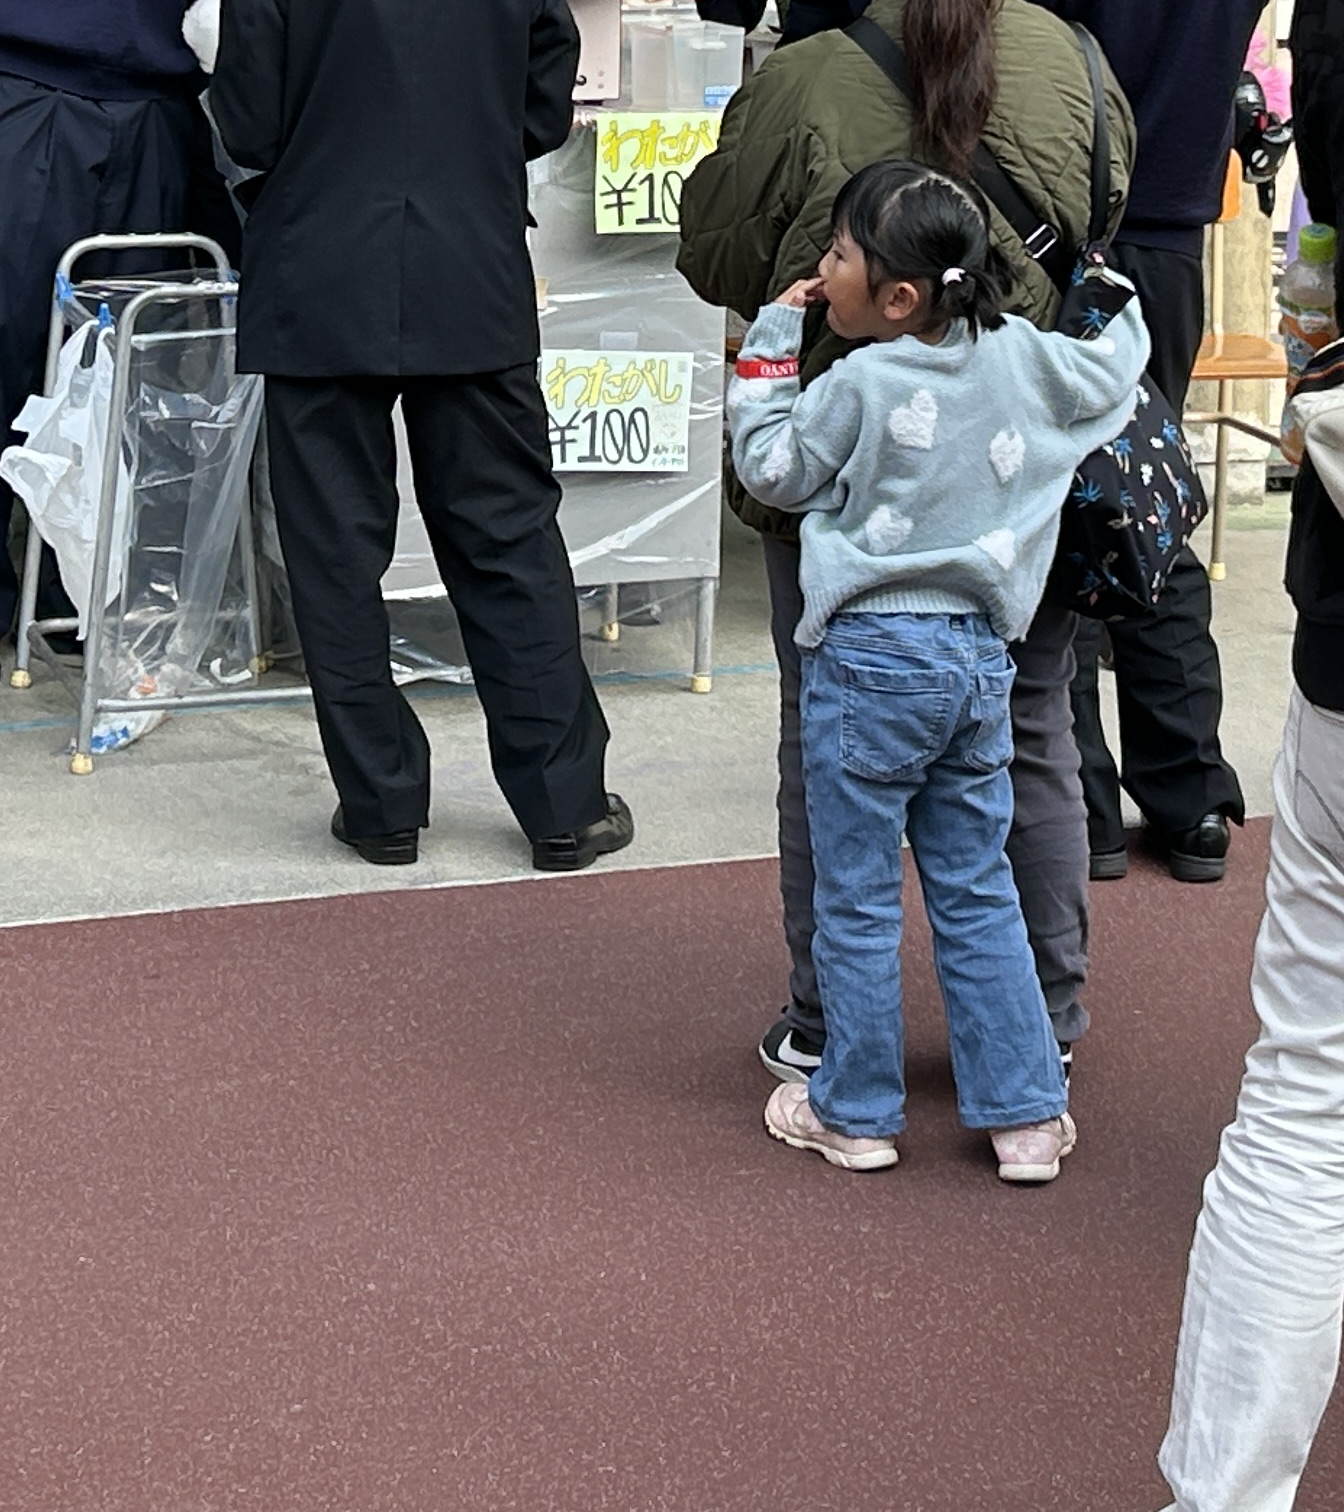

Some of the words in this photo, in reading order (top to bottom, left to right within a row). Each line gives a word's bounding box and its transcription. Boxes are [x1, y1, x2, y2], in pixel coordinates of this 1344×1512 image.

[600, 119, 723, 173] わたが
[600, 170, 682, 227] ¥10
[547, 356, 683, 409] わたがし
[547, 407, 651, 465] ¥100
